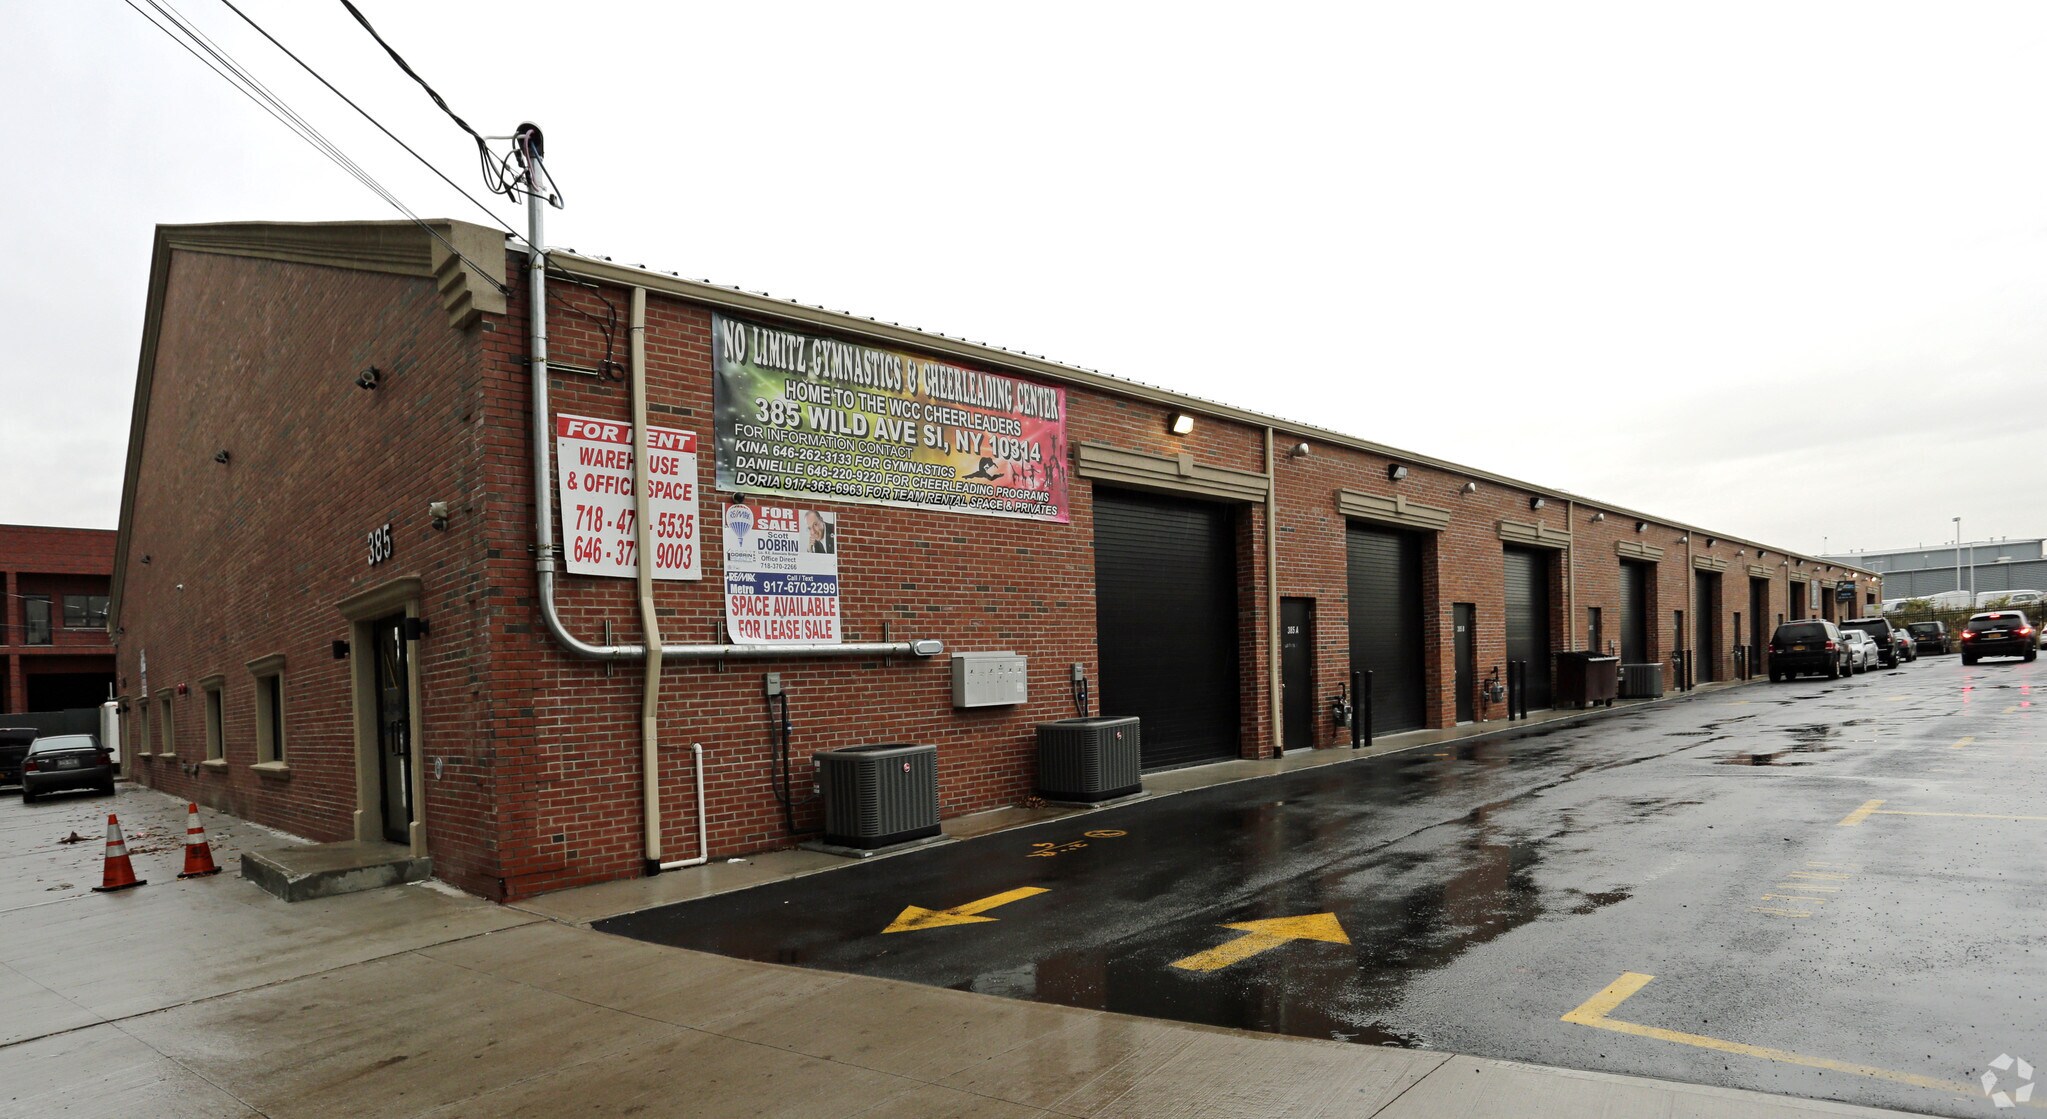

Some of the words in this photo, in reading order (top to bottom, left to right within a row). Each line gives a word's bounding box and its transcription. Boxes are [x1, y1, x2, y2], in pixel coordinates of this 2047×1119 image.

[723, 319, 747, 363] NO
[752, 326, 806, 372] LIMITZ
[812, 338, 902, 390] GYMNASTICS
[907, 358, 917, 396] &
[923, 360, 1013, 410] CHEERLEADING
[1016, 383, 1060, 420] CENTER
[784, 379, 832, 405] HOME
[834, 387, 854, 409] TO
[856, 391, 886, 413] THE
[888, 398, 921, 419] WCC
[924, 402, 1022, 437] CHEERLEADERS
[567, 420, 619, 442] FOR
[626, 428, 691, 450] ENT
[734, 423, 765, 440] FOR
[767, 427, 856, 452] INFORMATION
[858, 440, 913, 459] CONTACT
[754, 397, 800, 427] 385
[807, 405, 869, 438] WILD
[873, 415, 917, 445] AVE
[955, 431, 986, 454] NY
[988, 439, 1042, 463] 10314
[579, 446, 680, 475] WAREHUSE
[735, 440, 769, 457] KINA
[772, 445, 853, 466] 646-262-3133
[855, 456, 881, 471] FOR
[882, 459, 956, 479] GYMNASTICS
[567, 471, 578, 491] &
[735, 455, 804, 476] DANIELLE
[806, 465, 883, 485] 646-220-9220
[885, 473, 910, 487] FOR
[912, 476, 995, 497] CHEERLEADING
[996, 487, 1050, 503] PROGRAMS
[735, 471, 782, 489] DORIA
[784, 477, 864, 497] 917-363-6963
[865, 485, 891, 500] FOR
[892, 489, 925, 503] TEAM
[925, 491, 968, 507] RENTAL
[969, 495, 1003, 511] SPACE
[1005, 501, 1013, 513] &
[1014, 502, 1058, 517] PRIVATES
[757, 518, 799, 532] SALE
[761, 506, 794, 519] FOR
[368, 523, 391, 566] 385
[655, 542, 693, 570] 9003
[757, 538, 799, 552] DOBRIN
[728, 572, 757, 582] RE/MAX
[730, 583, 755, 595] Metro
[763, 580, 836, 594] 917-670-2299
[731, 595, 770, 617] SPACE
[773, 597, 836, 617] AVAILABLE
[738, 619, 761, 639] FOR
[764, 619, 833, 640] LEASE/SALE
